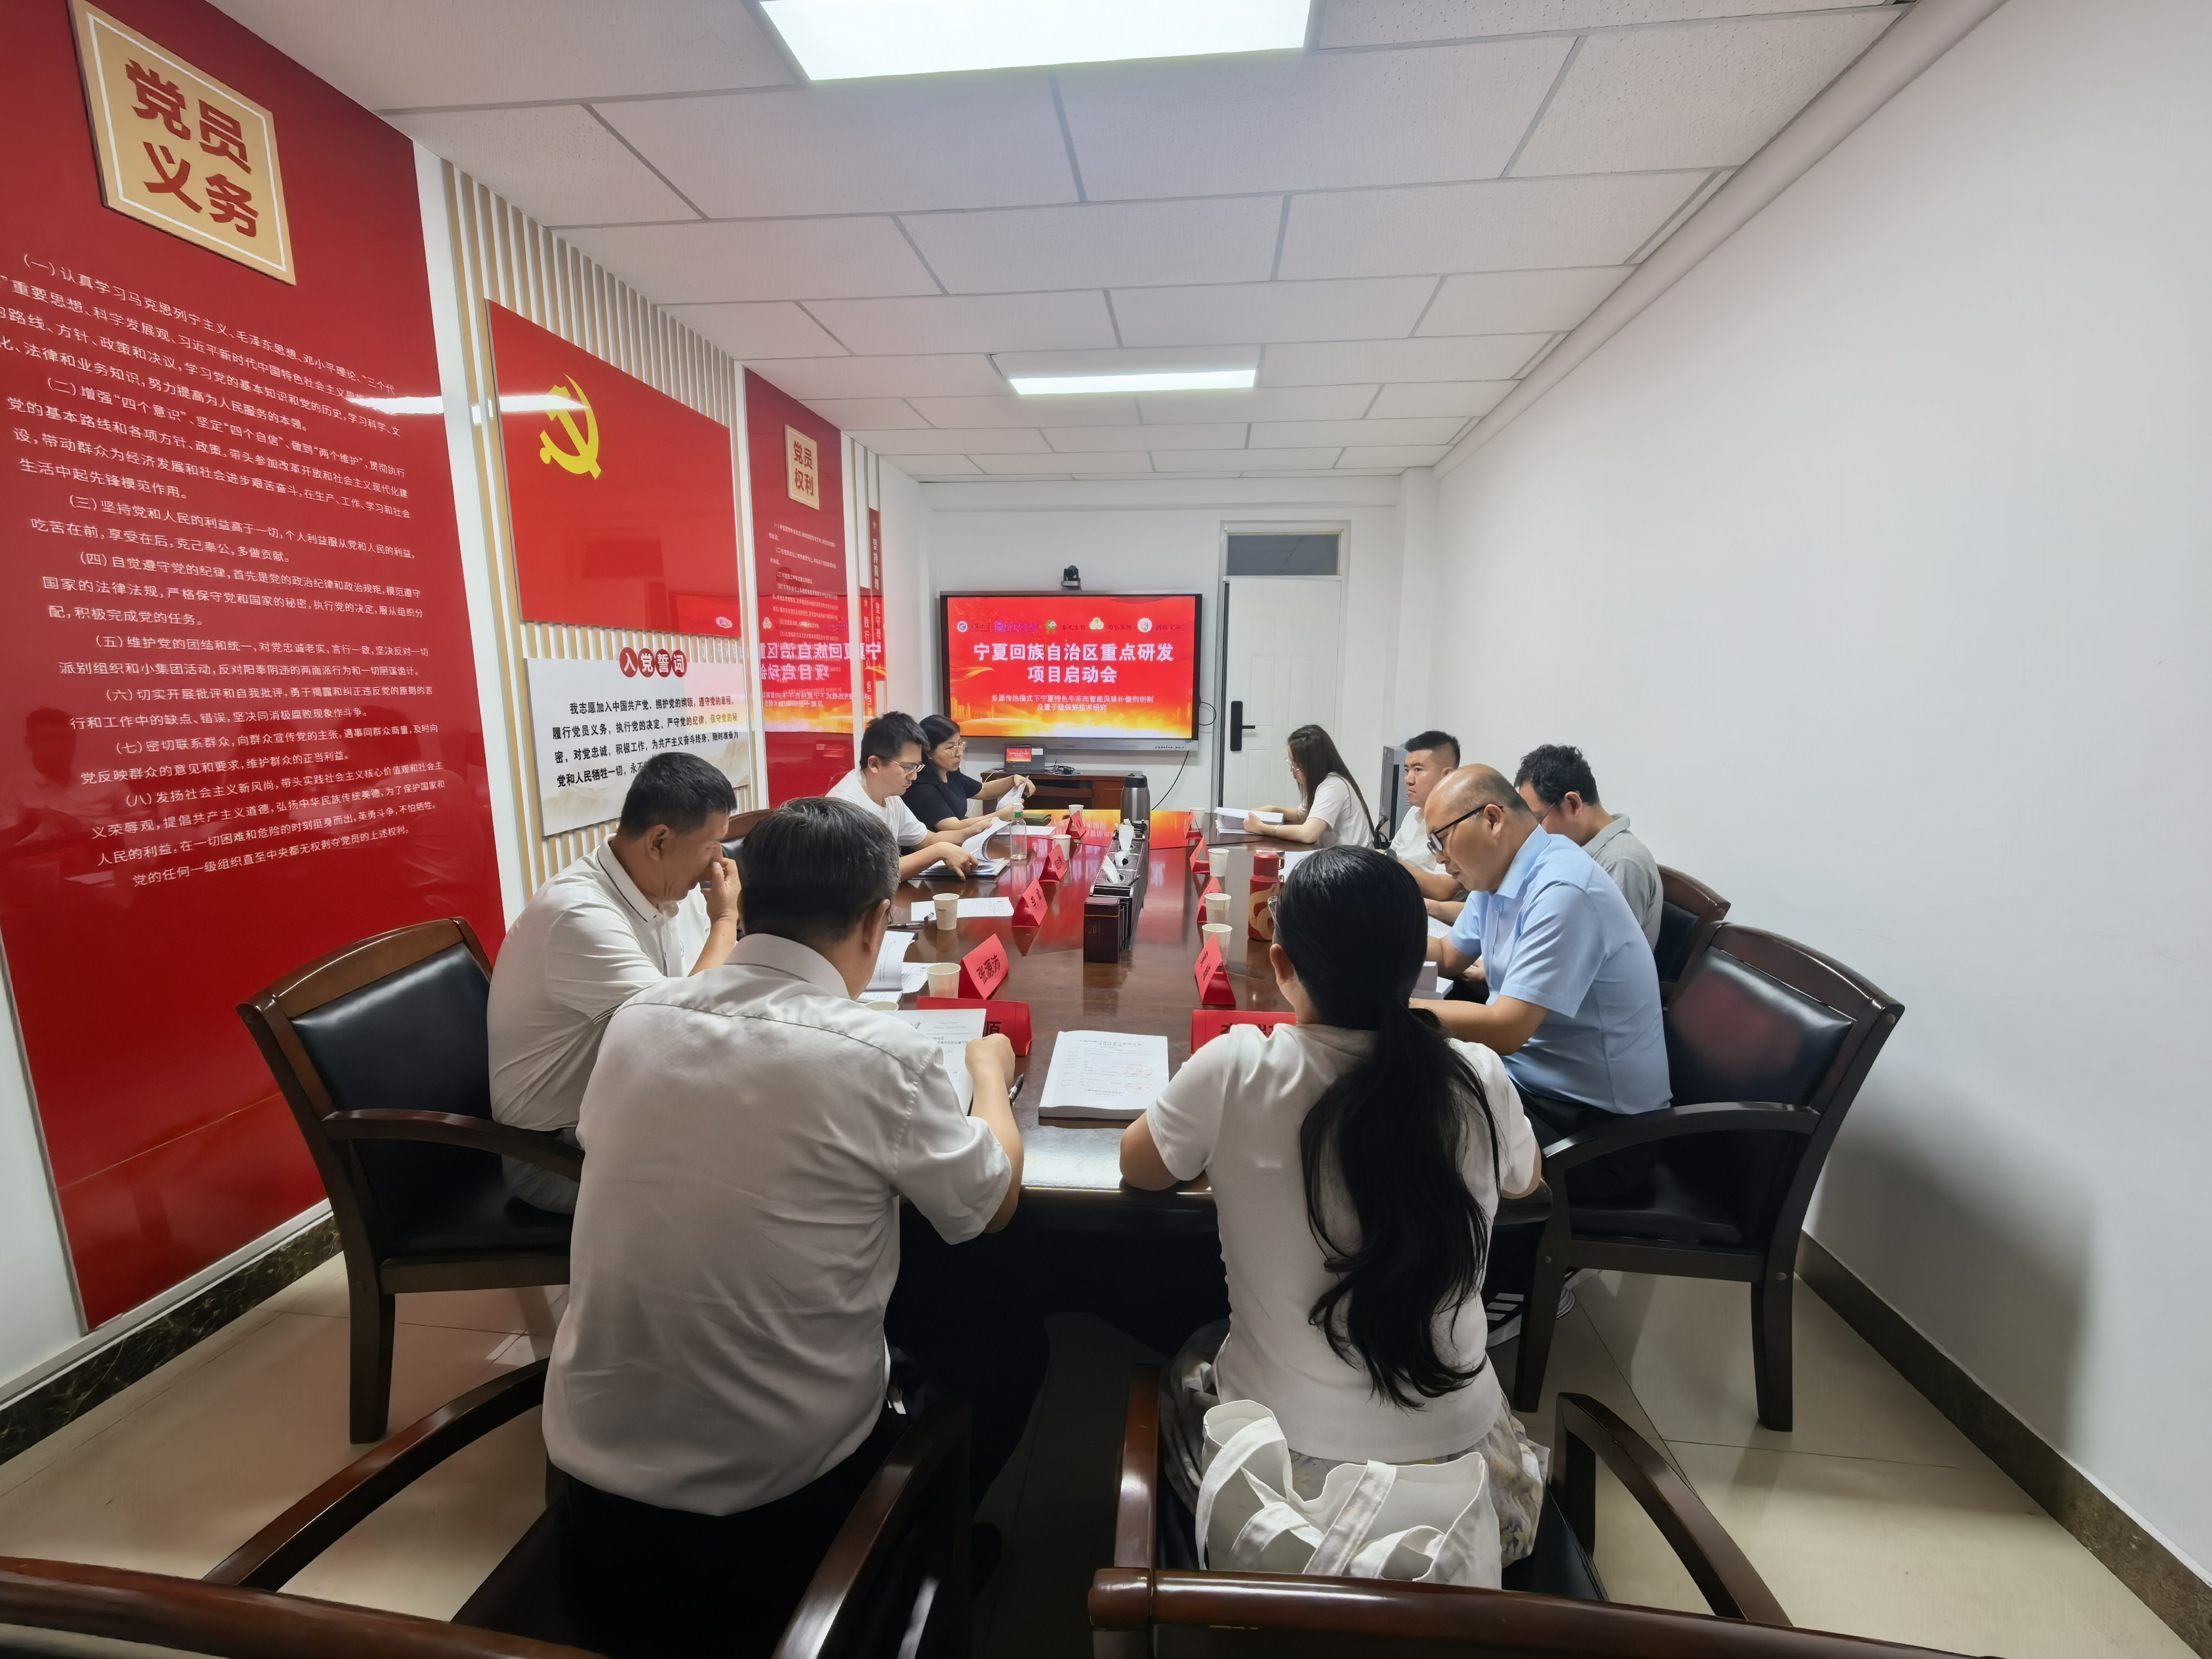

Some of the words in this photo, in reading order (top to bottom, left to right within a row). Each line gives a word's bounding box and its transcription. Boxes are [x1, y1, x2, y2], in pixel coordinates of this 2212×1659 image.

[125, 58, 252, 174] 党员
[143, 141, 258, 238] 义务
[793, 440, 813, 470] 党员
[19, 458, 187, 500] 生活中起先锋模范作用。
[794, 468, 814, 496] 权利
[48, 605, 203, 626] 配，积极完成党的任务。
[623, 650, 686, 674] 入党誓词
[974, 643, 1174, 662] 宁夏回族自治区重点研发
[1028, 665, 1117, 684] 项目启动会
[80, 751, 349, 785] 党反映群众的意见和要求，维护群众的正当利益。
